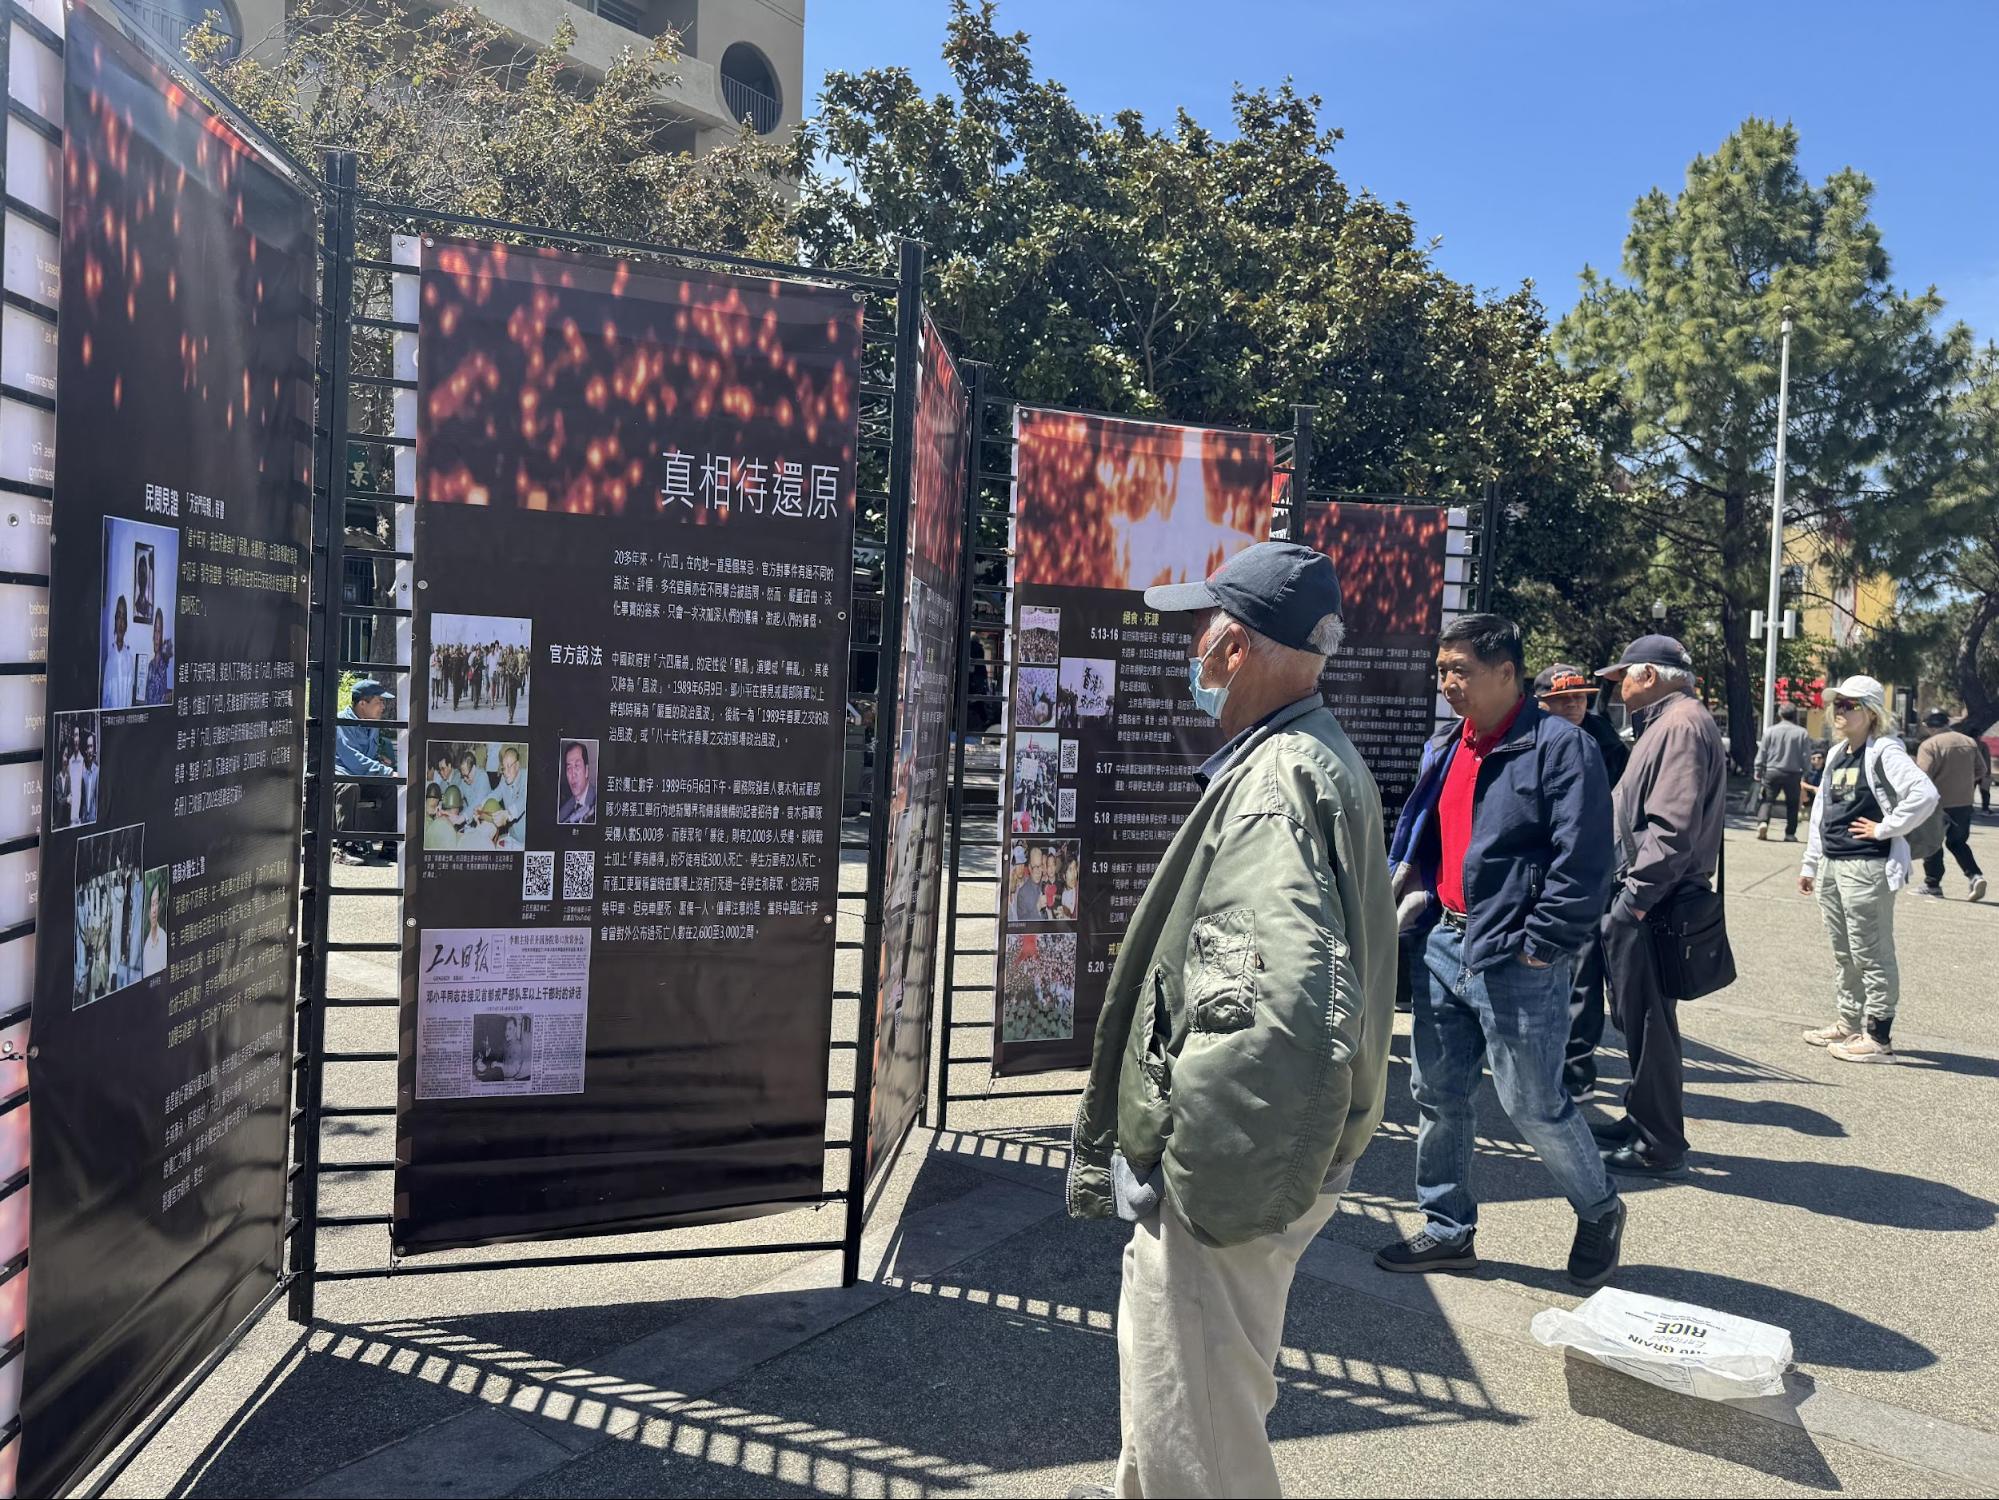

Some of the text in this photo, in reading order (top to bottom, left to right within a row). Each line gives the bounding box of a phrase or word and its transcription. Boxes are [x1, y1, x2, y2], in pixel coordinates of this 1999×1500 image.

[661, 448, 840, 520] 真相待還原
[144, 483, 180, 518] 民間見證
[1090, 627, 1119, 640] 5.13-16
[549, 644, 603, 666] 官方說法
[1096, 762, 1113, 774] 5.17
[1094, 812, 1110, 824] 5.18
[1092, 862, 1108, 874] 5.19
[1088, 960, 1105, 973] 5.20
[1654, 1322, 1706, 1338] RICE
[1628, 1334, 1674, 1354] GRAIN
